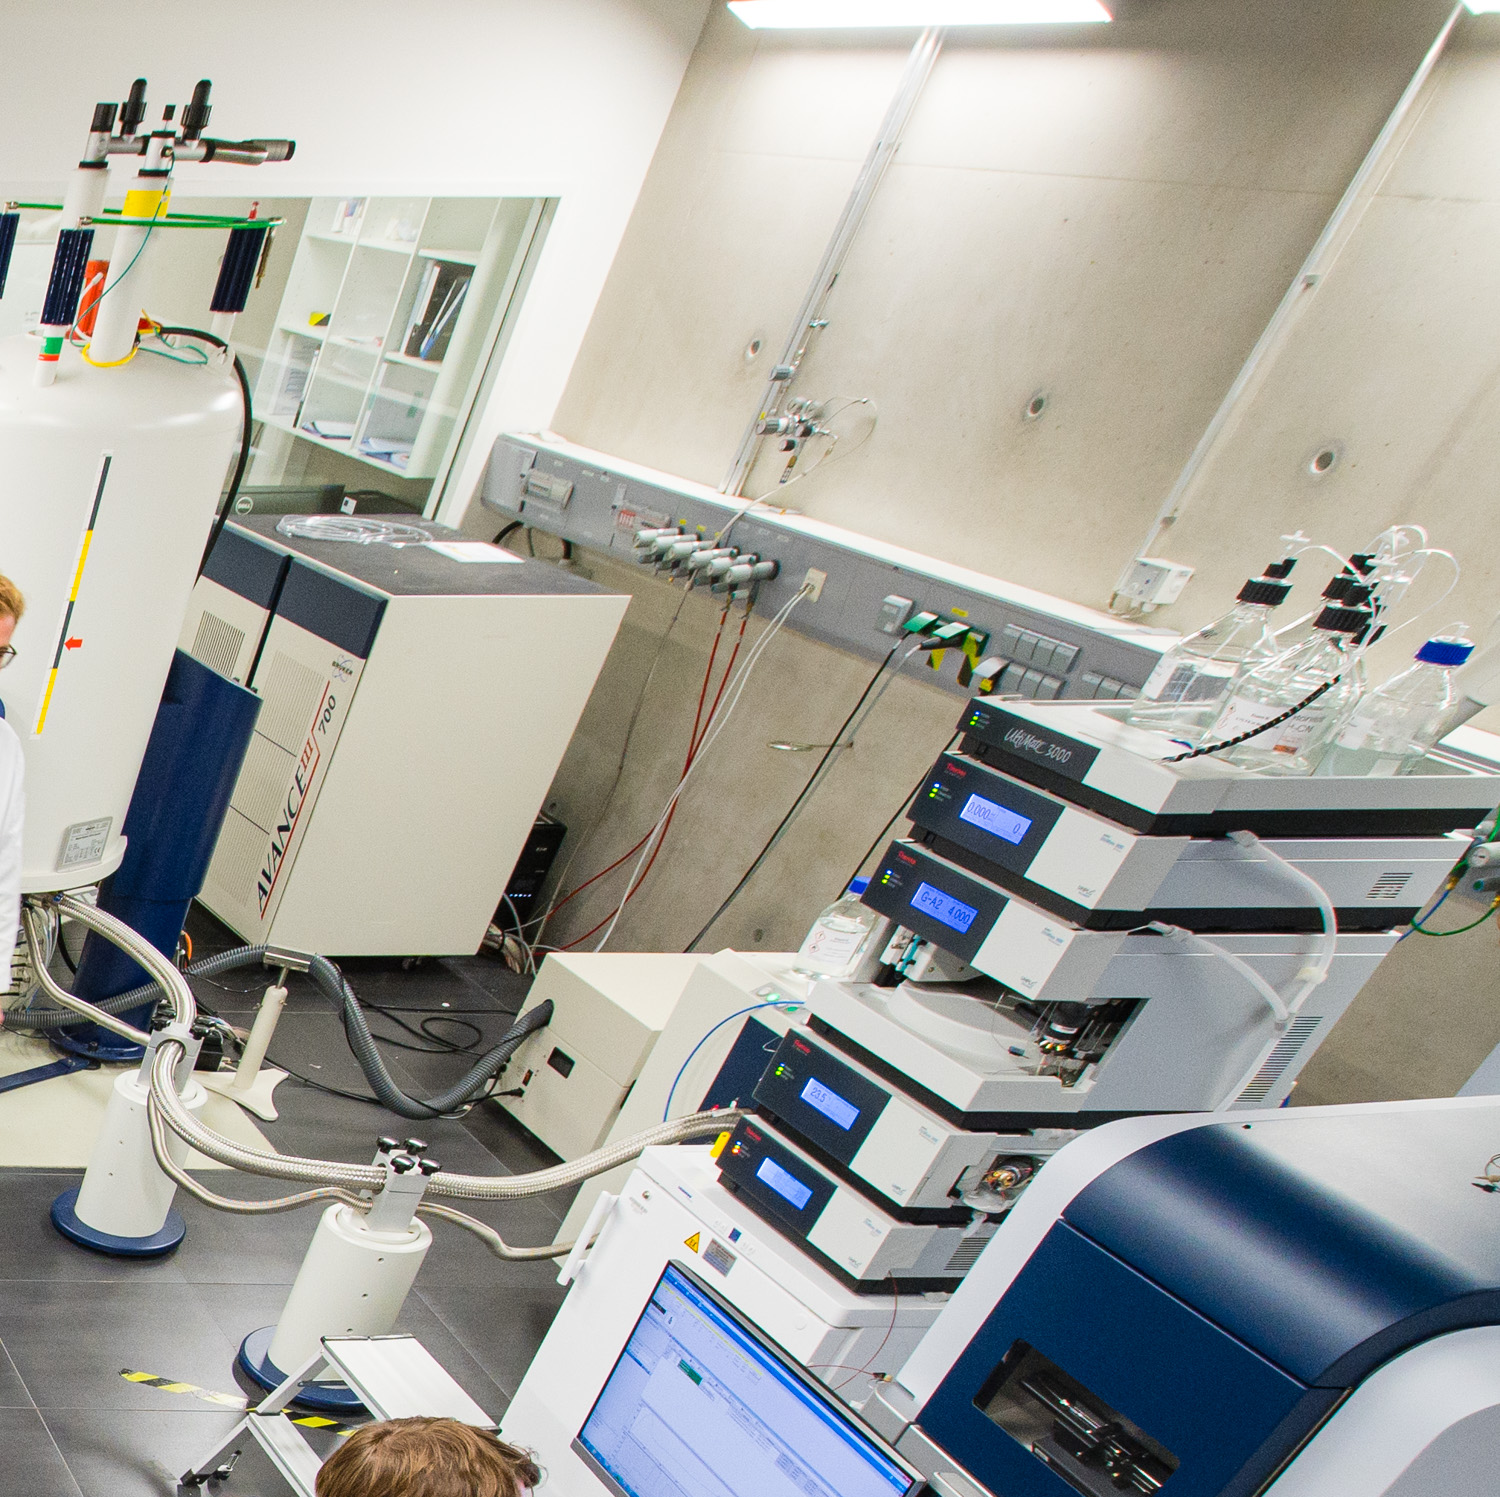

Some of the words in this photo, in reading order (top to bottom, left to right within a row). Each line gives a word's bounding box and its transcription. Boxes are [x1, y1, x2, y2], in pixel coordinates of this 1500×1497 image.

[317, 695, 337, 735] 700
[1044, 743, 1072, 764] 3000
[966, 800, 991, 821] 0.000
[256, 763, 308, 914] AVANCE
[920, 891, 943, 911] G-A2
[810, 1086, 828, 1103] 23.5
